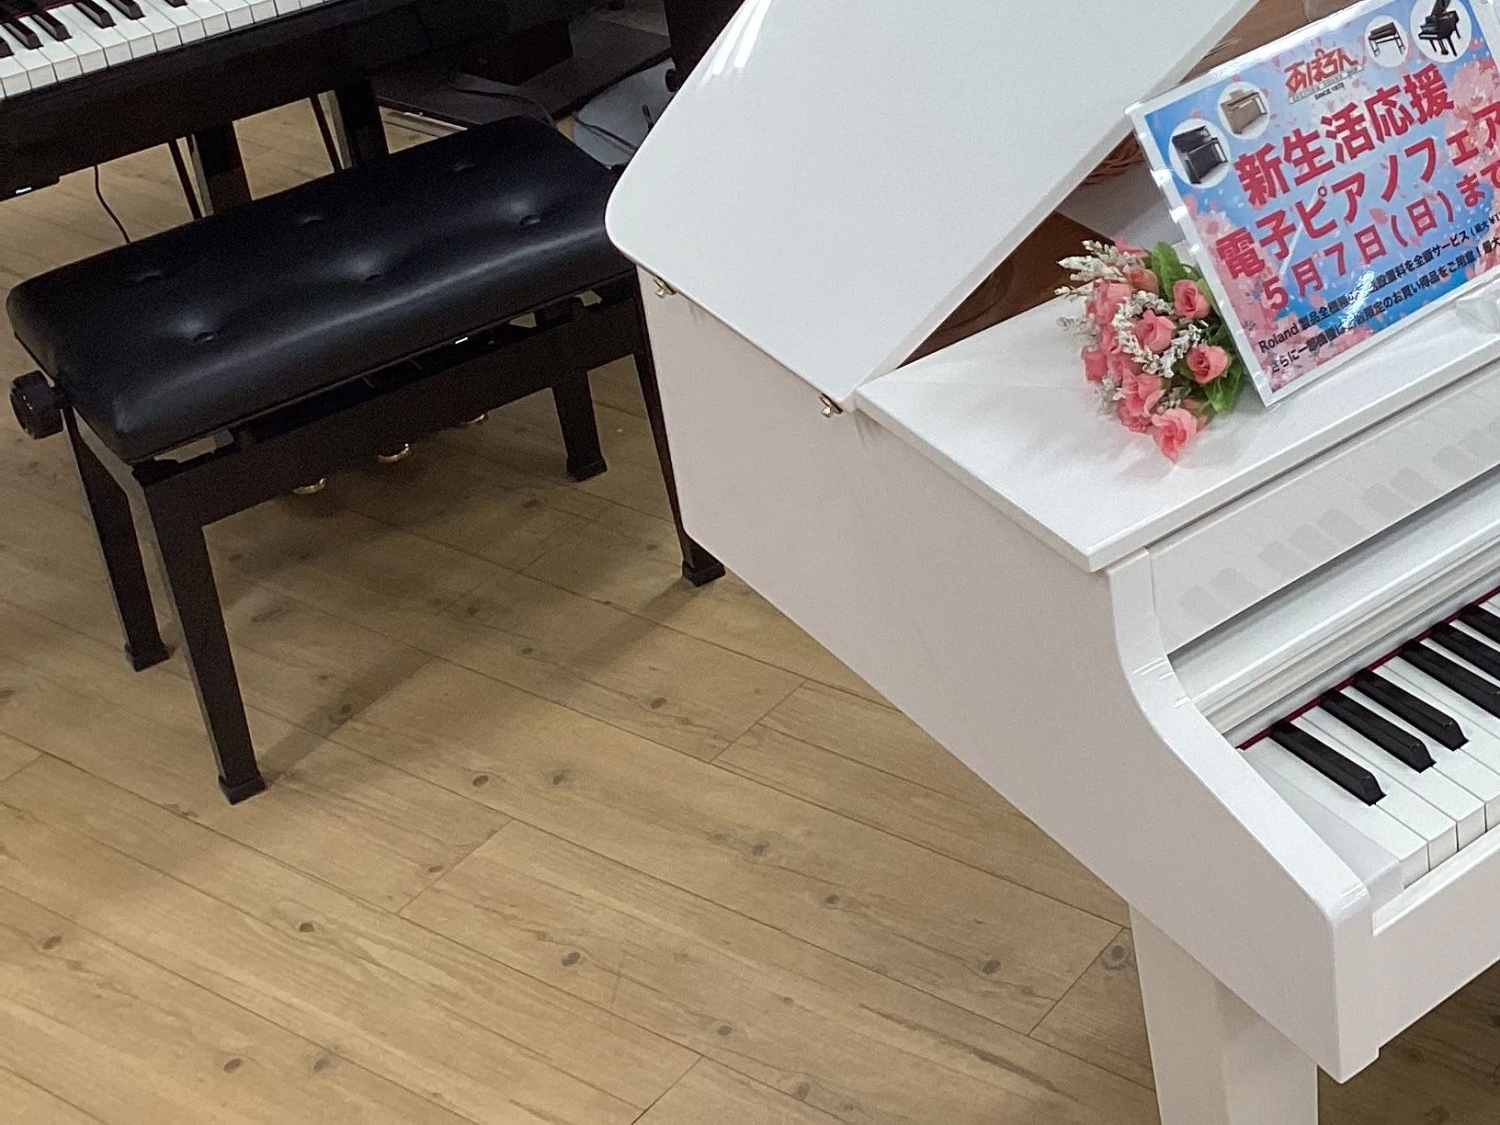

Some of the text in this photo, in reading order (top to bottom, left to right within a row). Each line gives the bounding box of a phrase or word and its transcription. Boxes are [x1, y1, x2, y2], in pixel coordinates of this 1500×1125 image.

[1233, 65, 1454, 208] 新生活応援
[1258, 321, 1301, 355] Roland
